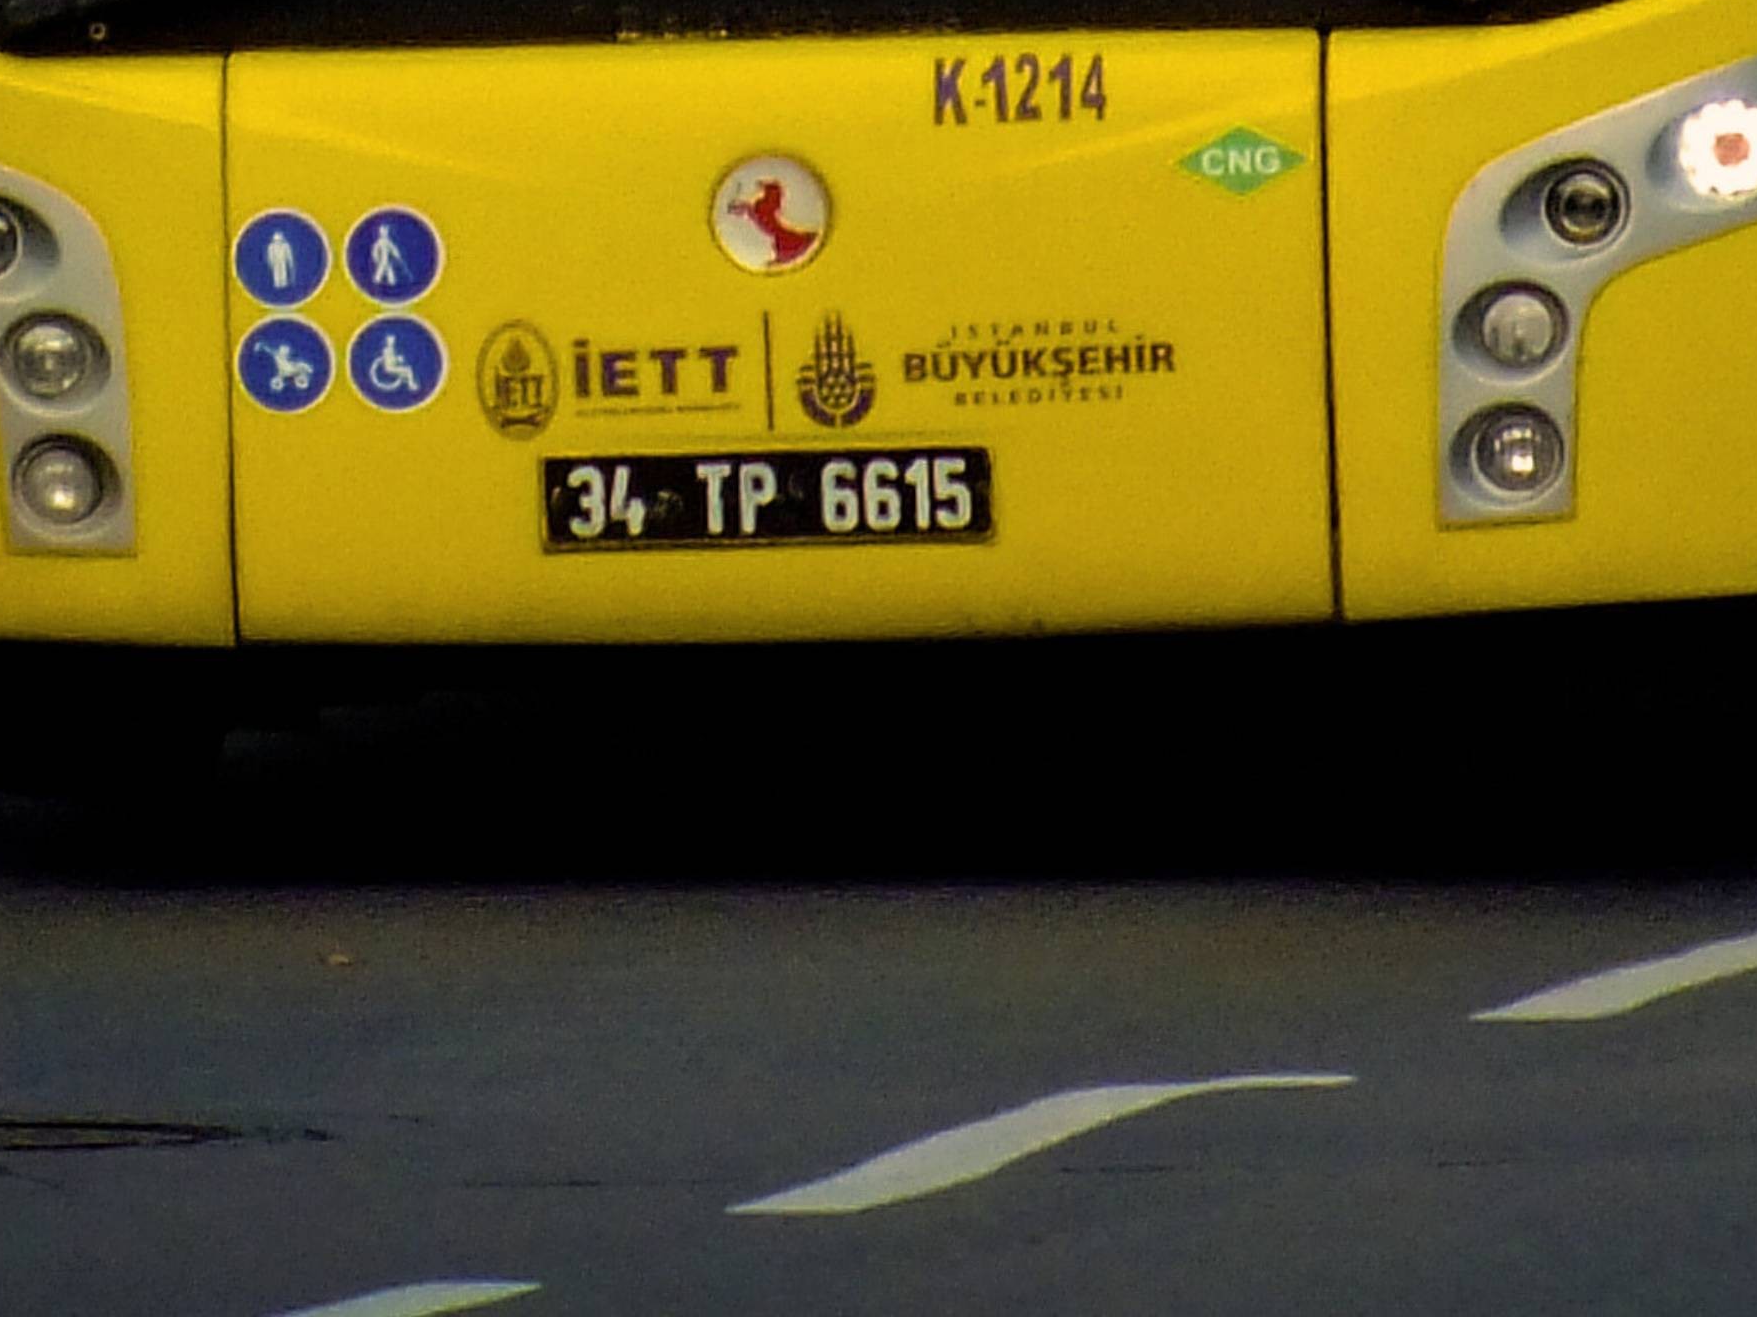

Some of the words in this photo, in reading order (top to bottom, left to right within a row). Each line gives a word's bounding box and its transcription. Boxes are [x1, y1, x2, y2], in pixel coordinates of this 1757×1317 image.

[933, 53, 1108, 126] K-1214
[1200, 145, 1282, 177] CNG
[573, 338, 739, 399] İETT
[903, 334, 1176, 387] BÜYÜKŞEHİR
[567, 465, 646, 538] 34
[696, 463, 778, 535] TP
[821, 457, 973, 533] 6615
